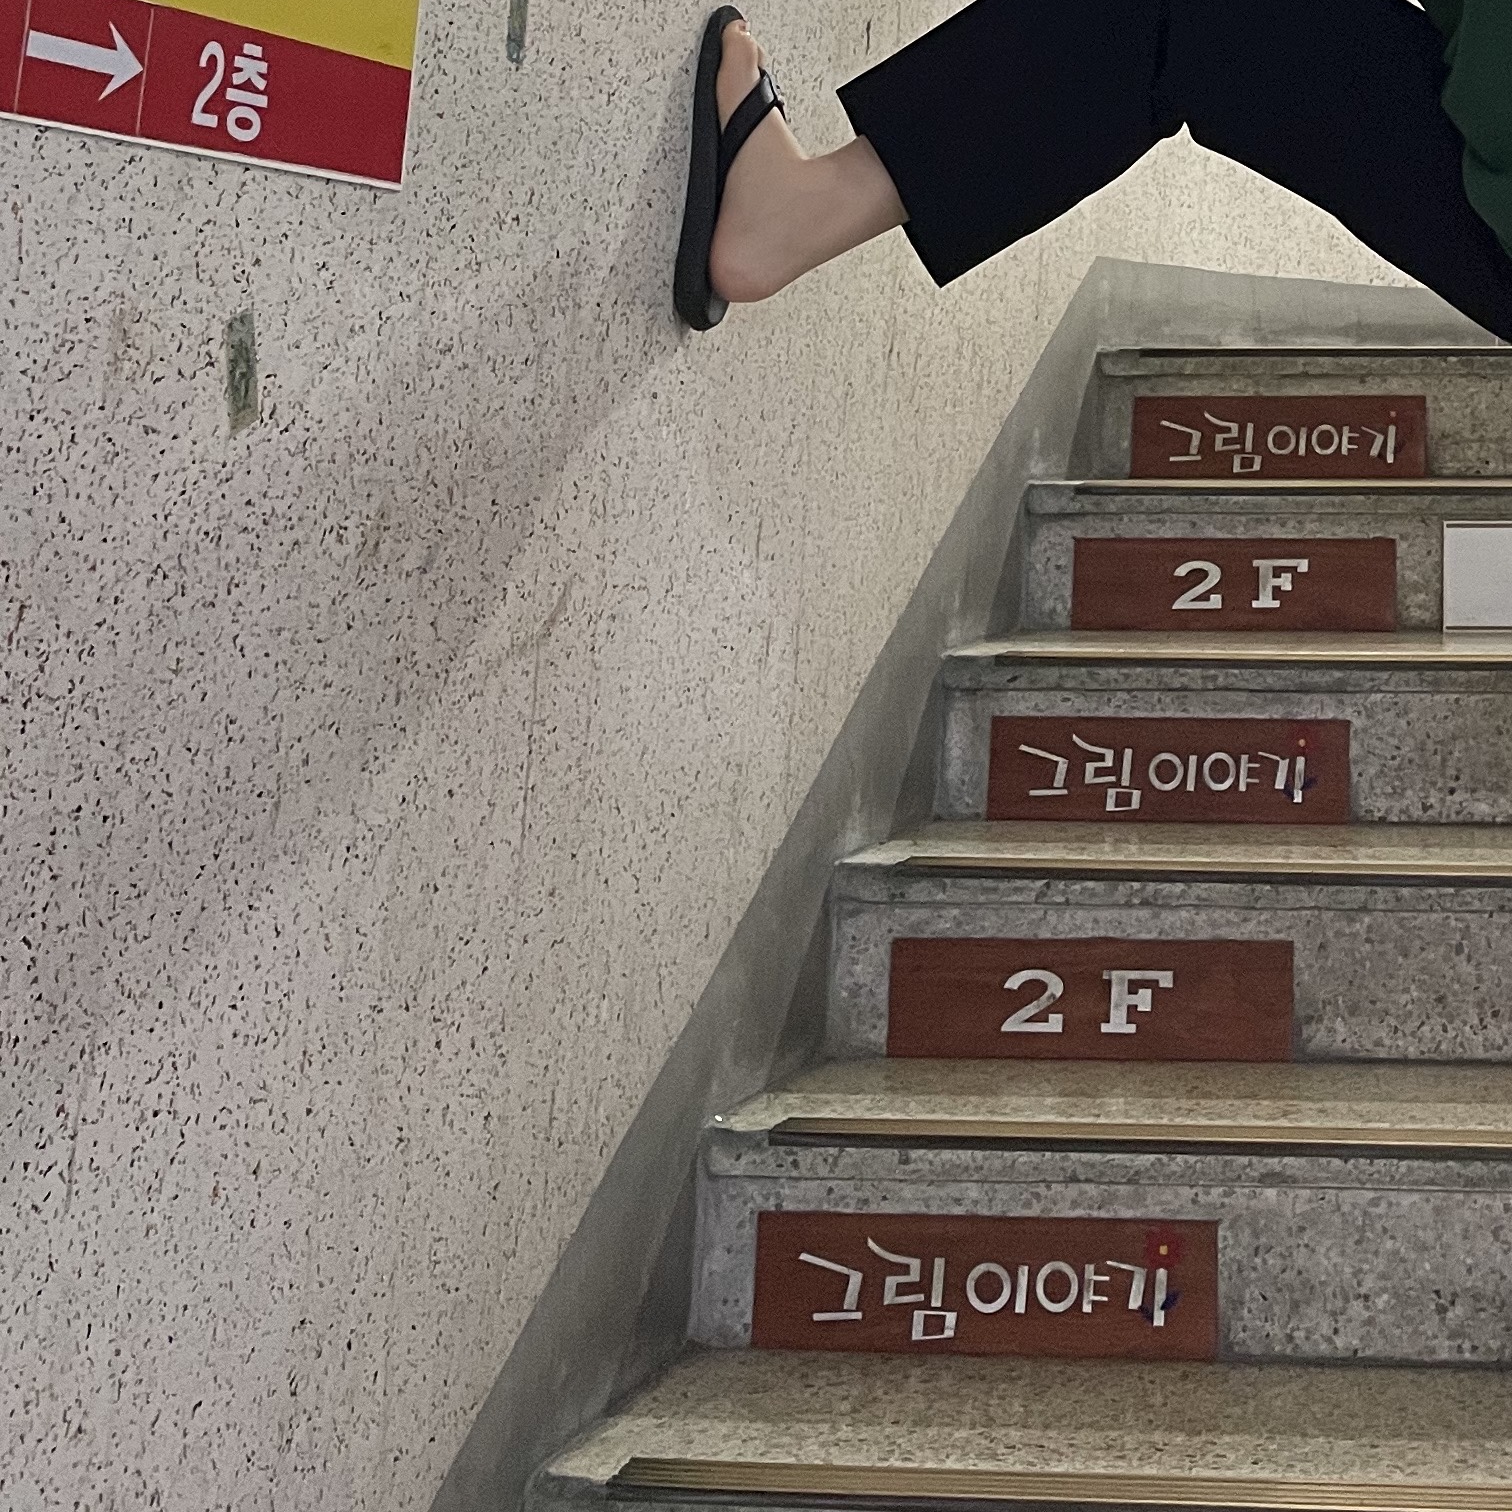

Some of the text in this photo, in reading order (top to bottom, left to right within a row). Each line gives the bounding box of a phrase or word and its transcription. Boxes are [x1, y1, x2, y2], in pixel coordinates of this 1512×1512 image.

[190, 40, 269, 143] 2층
[1160, 410, 1397, 473] 그림이야기
[1019, 732, 1305, 812] 그림이야기
[798, 1236, 1168, 1341] 그림이야기
